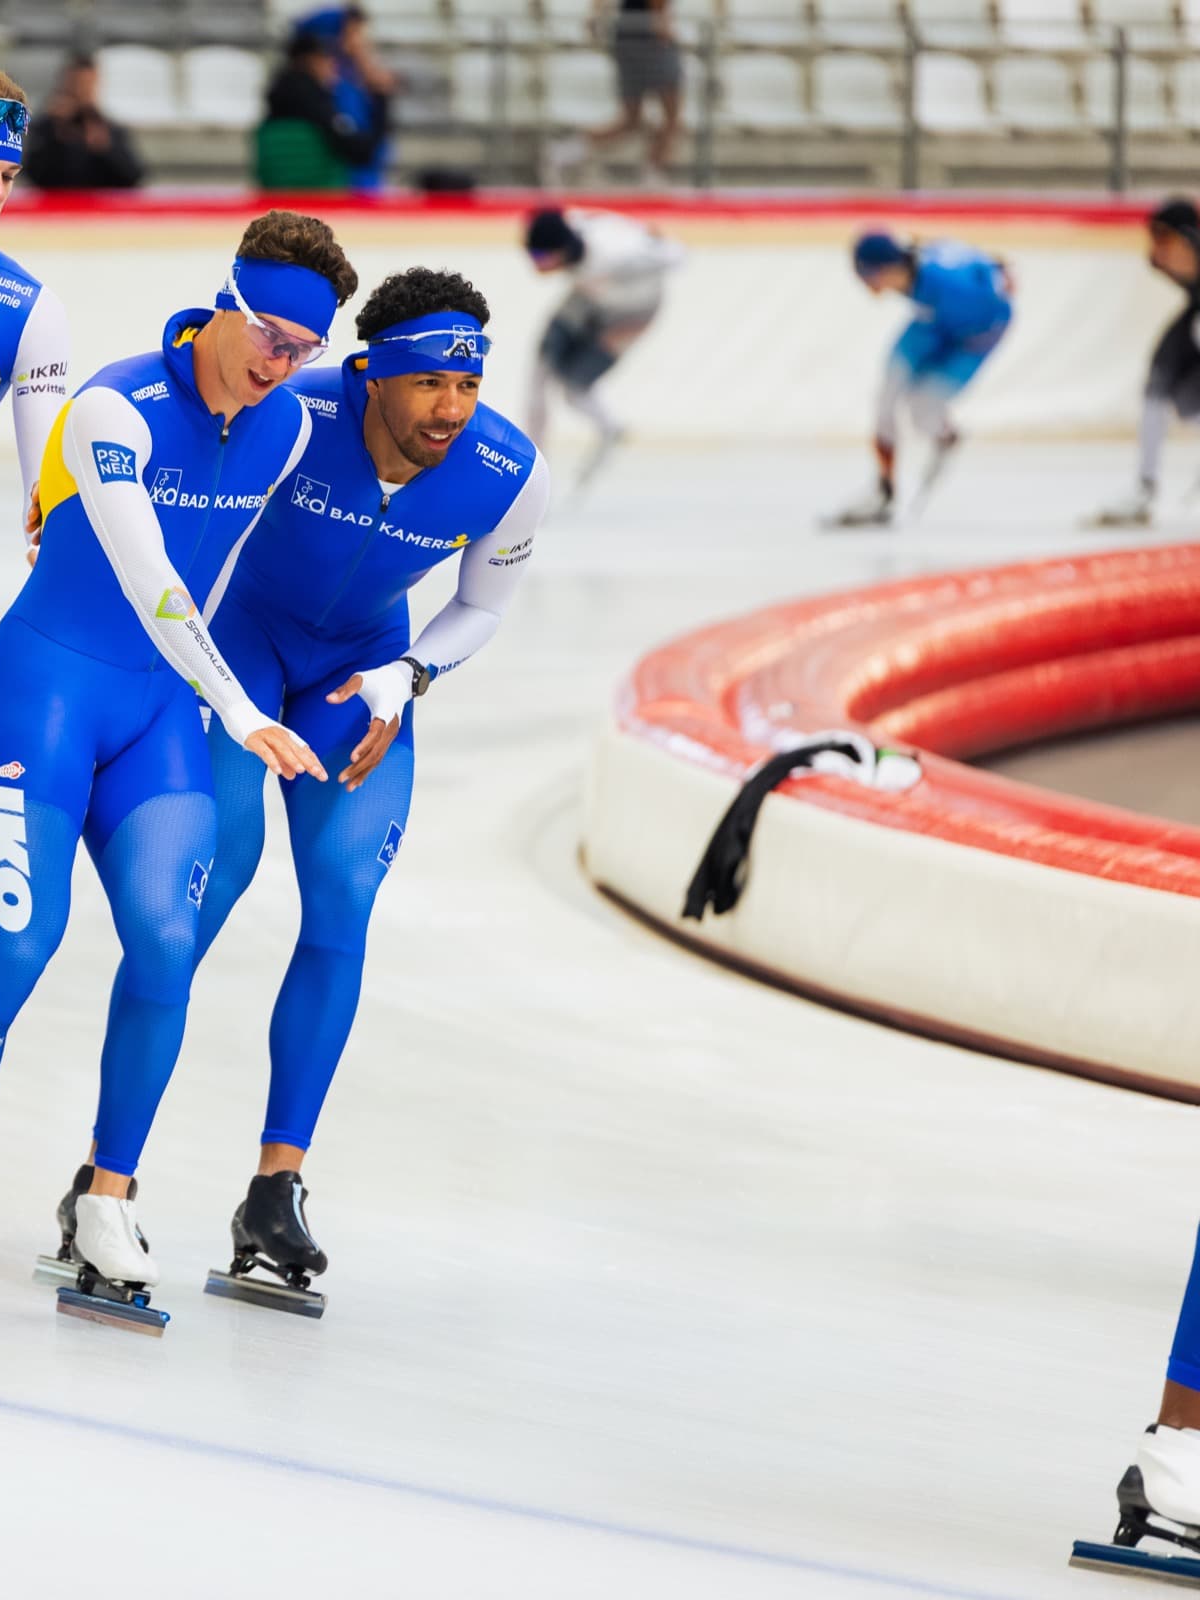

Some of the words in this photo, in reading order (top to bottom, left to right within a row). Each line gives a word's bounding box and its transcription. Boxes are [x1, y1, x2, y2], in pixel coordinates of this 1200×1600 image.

[130, 380, 168, 402] FRISTADS
[96, 449, 132, 464] PSY
[99, 463, 134, 475] NED
[179, 493, 210, 508] BAD
[329, 507, 374, 527] BAD
[378, 521, 454, 550] KAMERS
[185, 619, 232, 683] SPECIALIST
